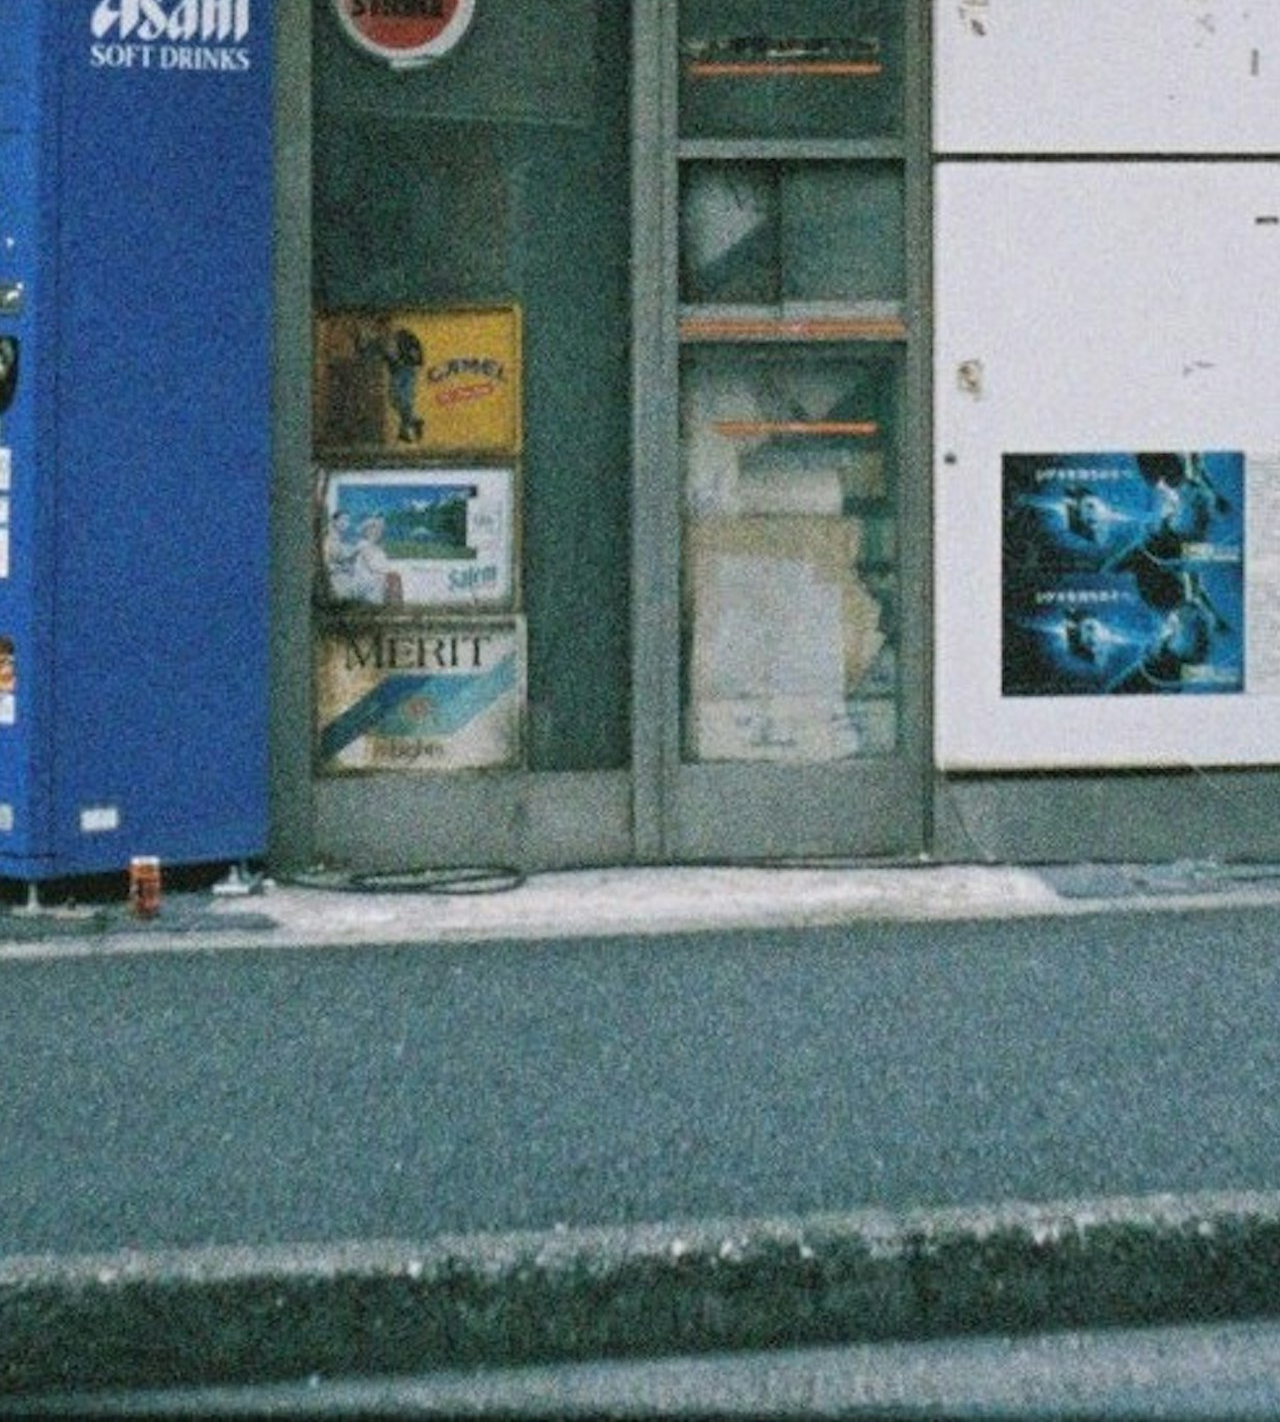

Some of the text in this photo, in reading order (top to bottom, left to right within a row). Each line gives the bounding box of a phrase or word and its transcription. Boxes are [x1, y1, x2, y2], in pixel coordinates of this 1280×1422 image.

[90, 43, 250, 71] SOFT DRINKS
[345, 634, 492, 670] MERIT
